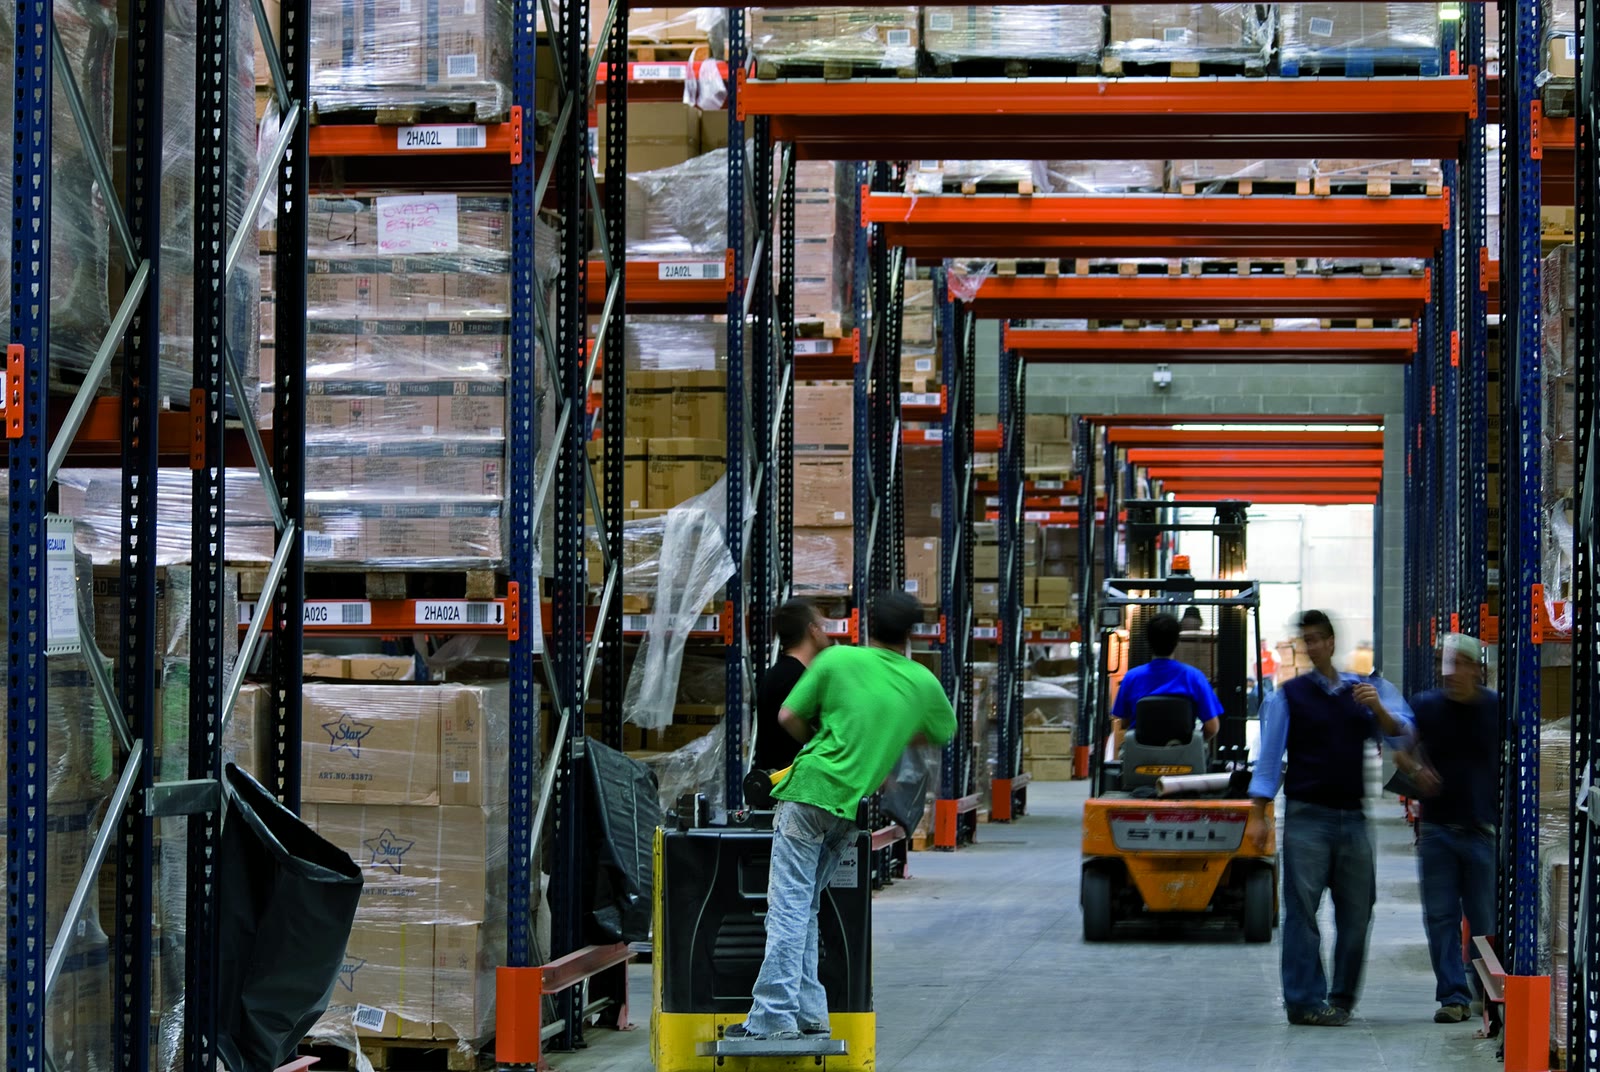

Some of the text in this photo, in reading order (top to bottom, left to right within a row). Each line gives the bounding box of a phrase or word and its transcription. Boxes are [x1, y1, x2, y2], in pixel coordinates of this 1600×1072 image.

[406, 130, 442, 146] 2HA02L
[334, 262, 358, 270] TREND
[665, 266, 692, 277] 2JA02L
[450, 322, 464, 334] AD
[454, 382, 468, 395] AD
[424, 605, 460, 621] 2HA02A
[335, 723, 362, 741] Star
[1127, 828, 1227, 842] STILL
[376, 839, 403, 857] Star
